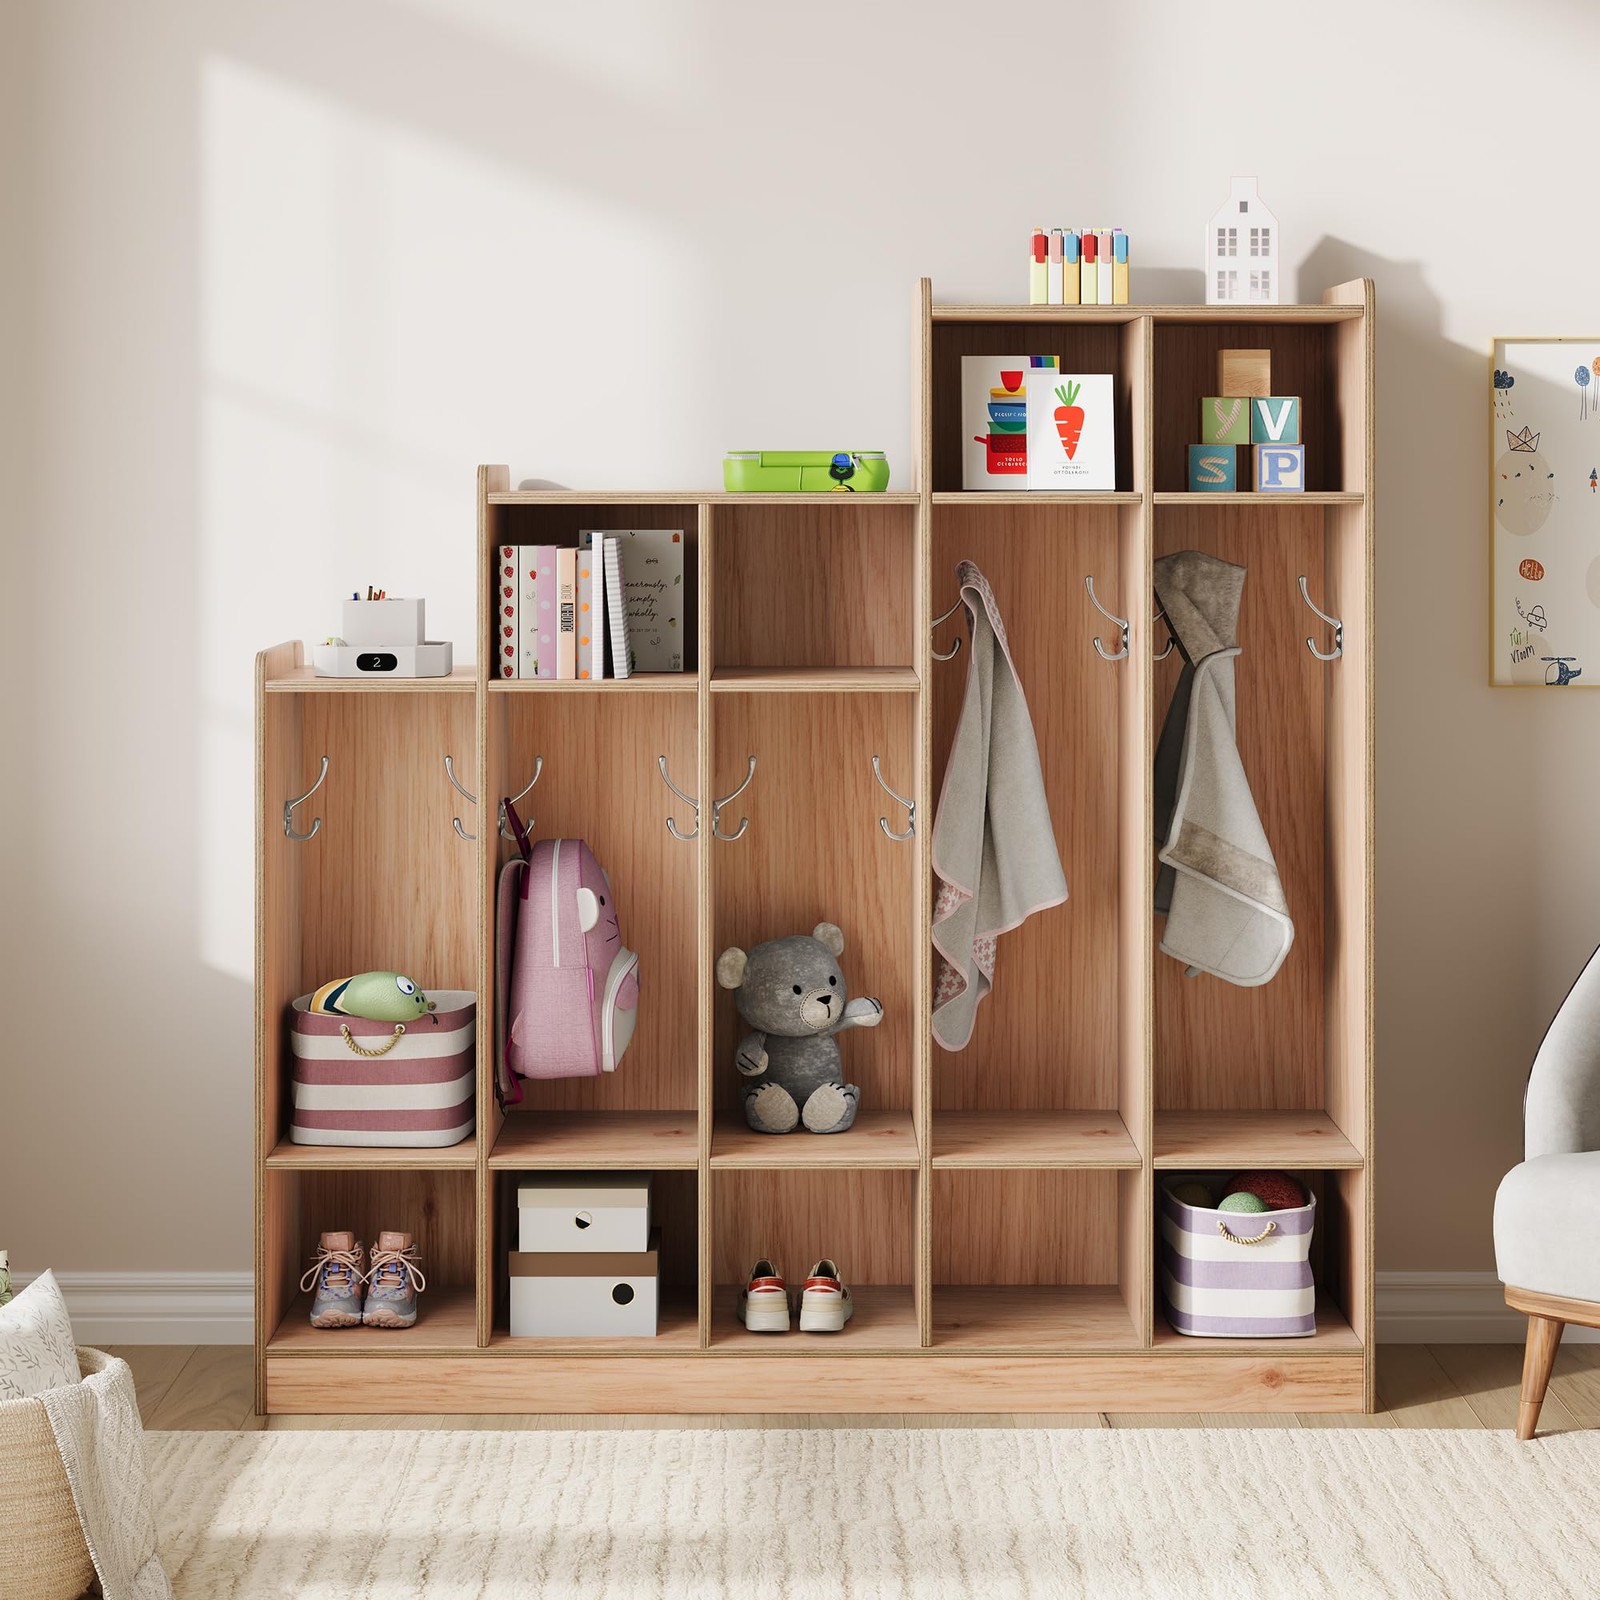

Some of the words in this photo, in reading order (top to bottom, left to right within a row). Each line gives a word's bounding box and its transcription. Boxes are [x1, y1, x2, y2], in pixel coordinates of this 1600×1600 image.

[1257, 399, 1294, 441] V
[1264, 452, 1299, 485] P
[561, 583, 572, 599] BOOK
[624, 579, 668, 593] enerously,
[561, 602, 573, 632] COLOR-IN
[373, 656, 381, 668] 2
